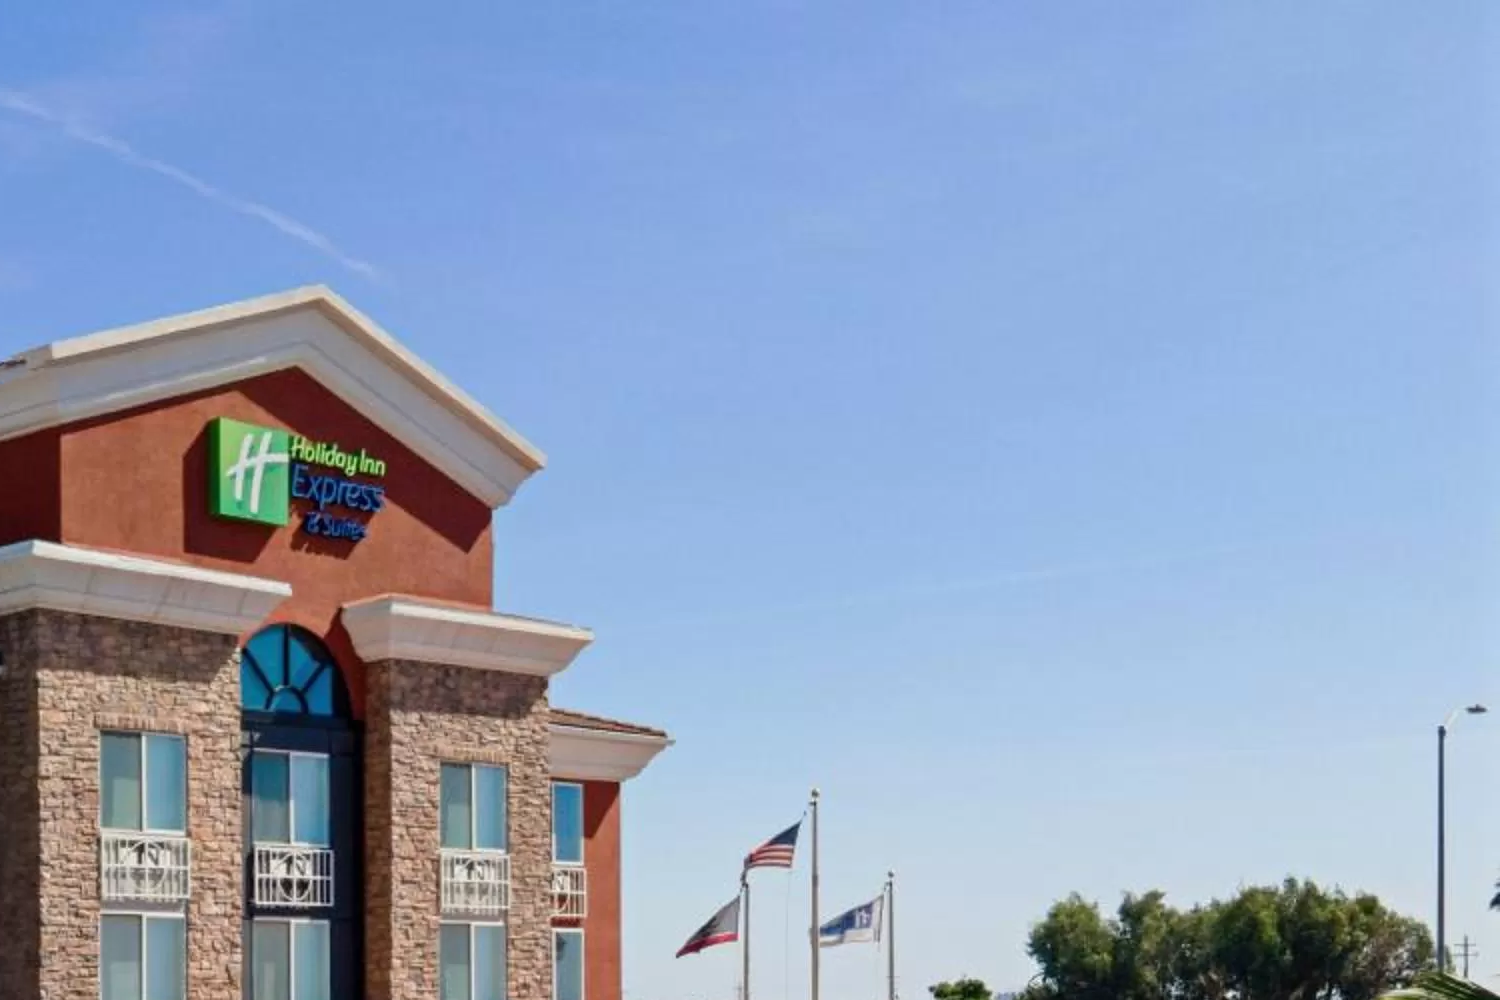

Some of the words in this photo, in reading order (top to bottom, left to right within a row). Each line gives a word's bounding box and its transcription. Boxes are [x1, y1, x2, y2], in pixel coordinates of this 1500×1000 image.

[291, 434, 358, 477] Holiday
[359, 448, 386, 477] Inn
[292, 463, 386, 512] Express
[306, 511, 321, 534] &
[322, 513, 368, 541] Suites
